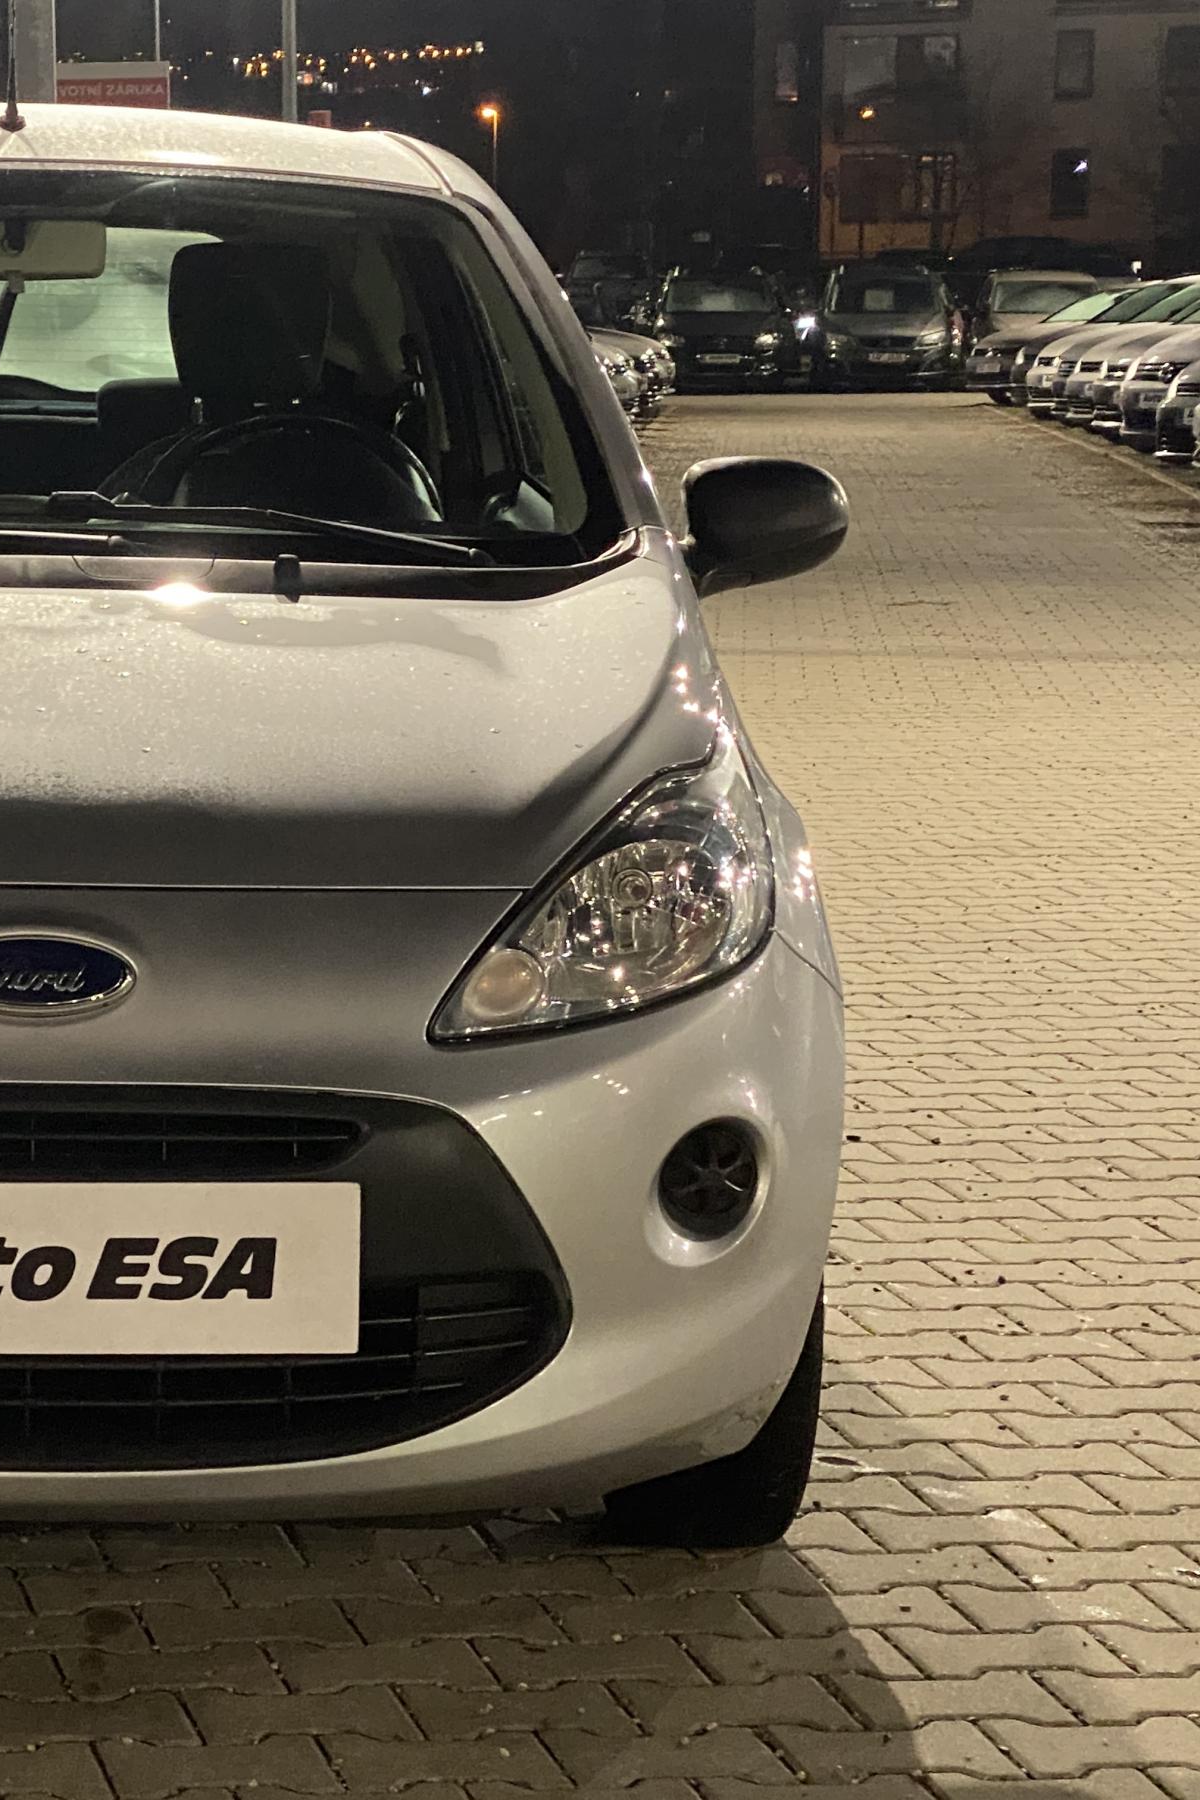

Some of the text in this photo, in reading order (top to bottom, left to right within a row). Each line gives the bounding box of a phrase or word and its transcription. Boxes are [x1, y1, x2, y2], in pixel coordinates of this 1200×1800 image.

[58, 80, 165, 97] VOTNÍ ZÁRUKA
[85, 1236, 278, 1300] ESA
